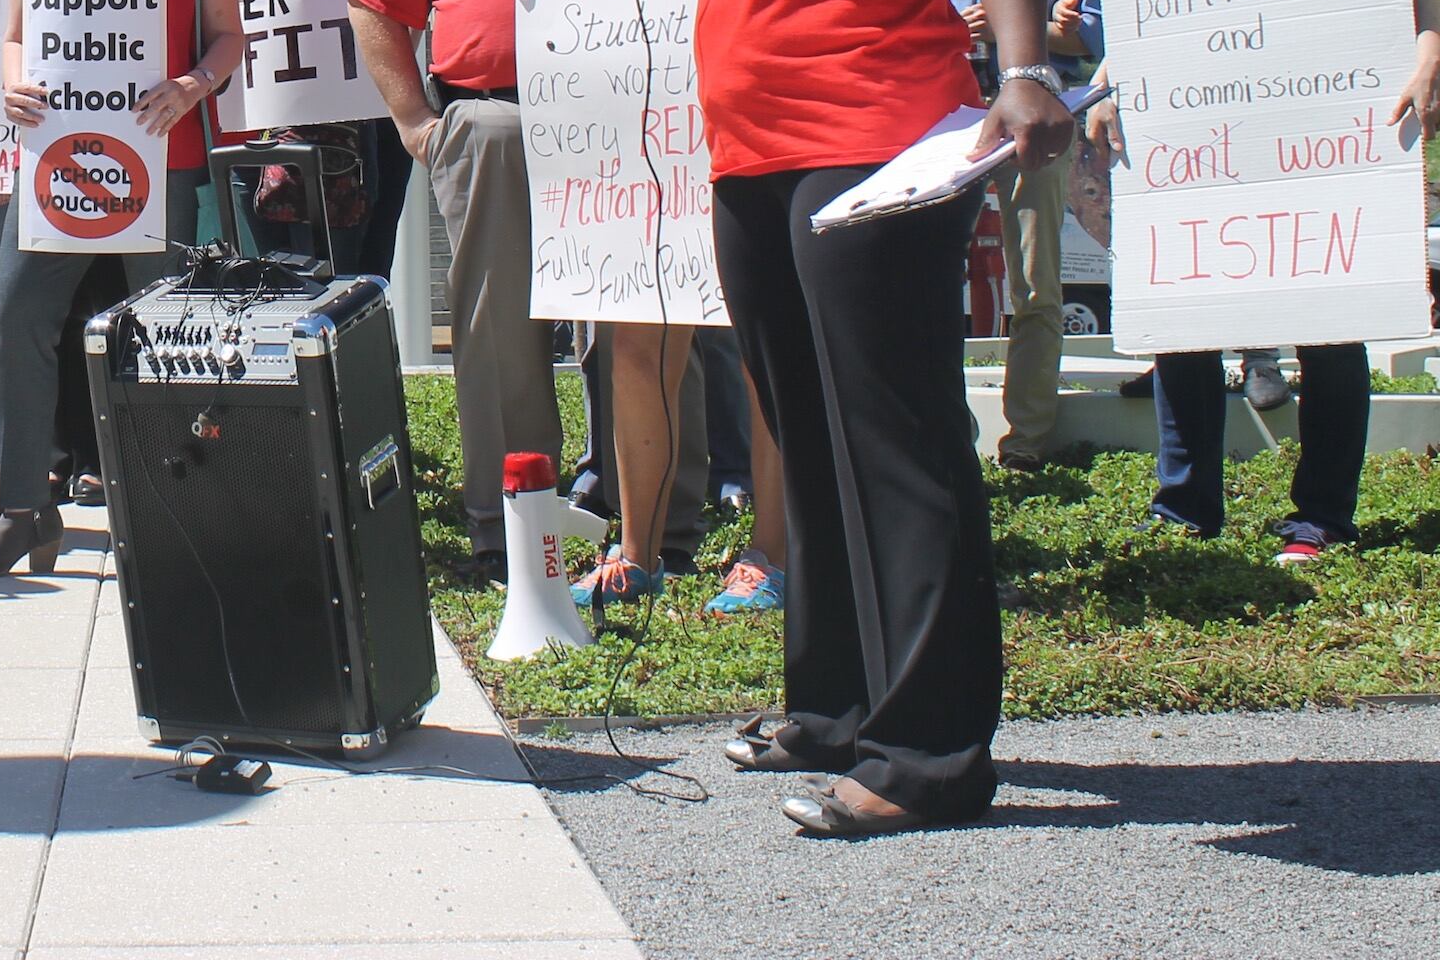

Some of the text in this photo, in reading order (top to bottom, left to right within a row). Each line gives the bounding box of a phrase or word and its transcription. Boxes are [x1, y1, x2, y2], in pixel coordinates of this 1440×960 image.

[41, 32, 145, 62] Public
[243, 17, 358, 88] FIT
[1207, 12, 1265, 53] and
[527, 72, 585, 107] are
[1169, 67, 1381, 110] commissioners
[72, 140, 105, 156] NO
[529, 123, 621, 168] every
[1277, 106, 1382, 173] won't
[52, 167, 131, 186] SCHOOL
[40, 195, 144, 214] VOUCHERS
[540, 158, 711, 246] #redforpublic
[658, 227, 714, 302] Publi
[1150, 206, 1363, 286] LISTEN
[191, 421, 221, 438] QFX
